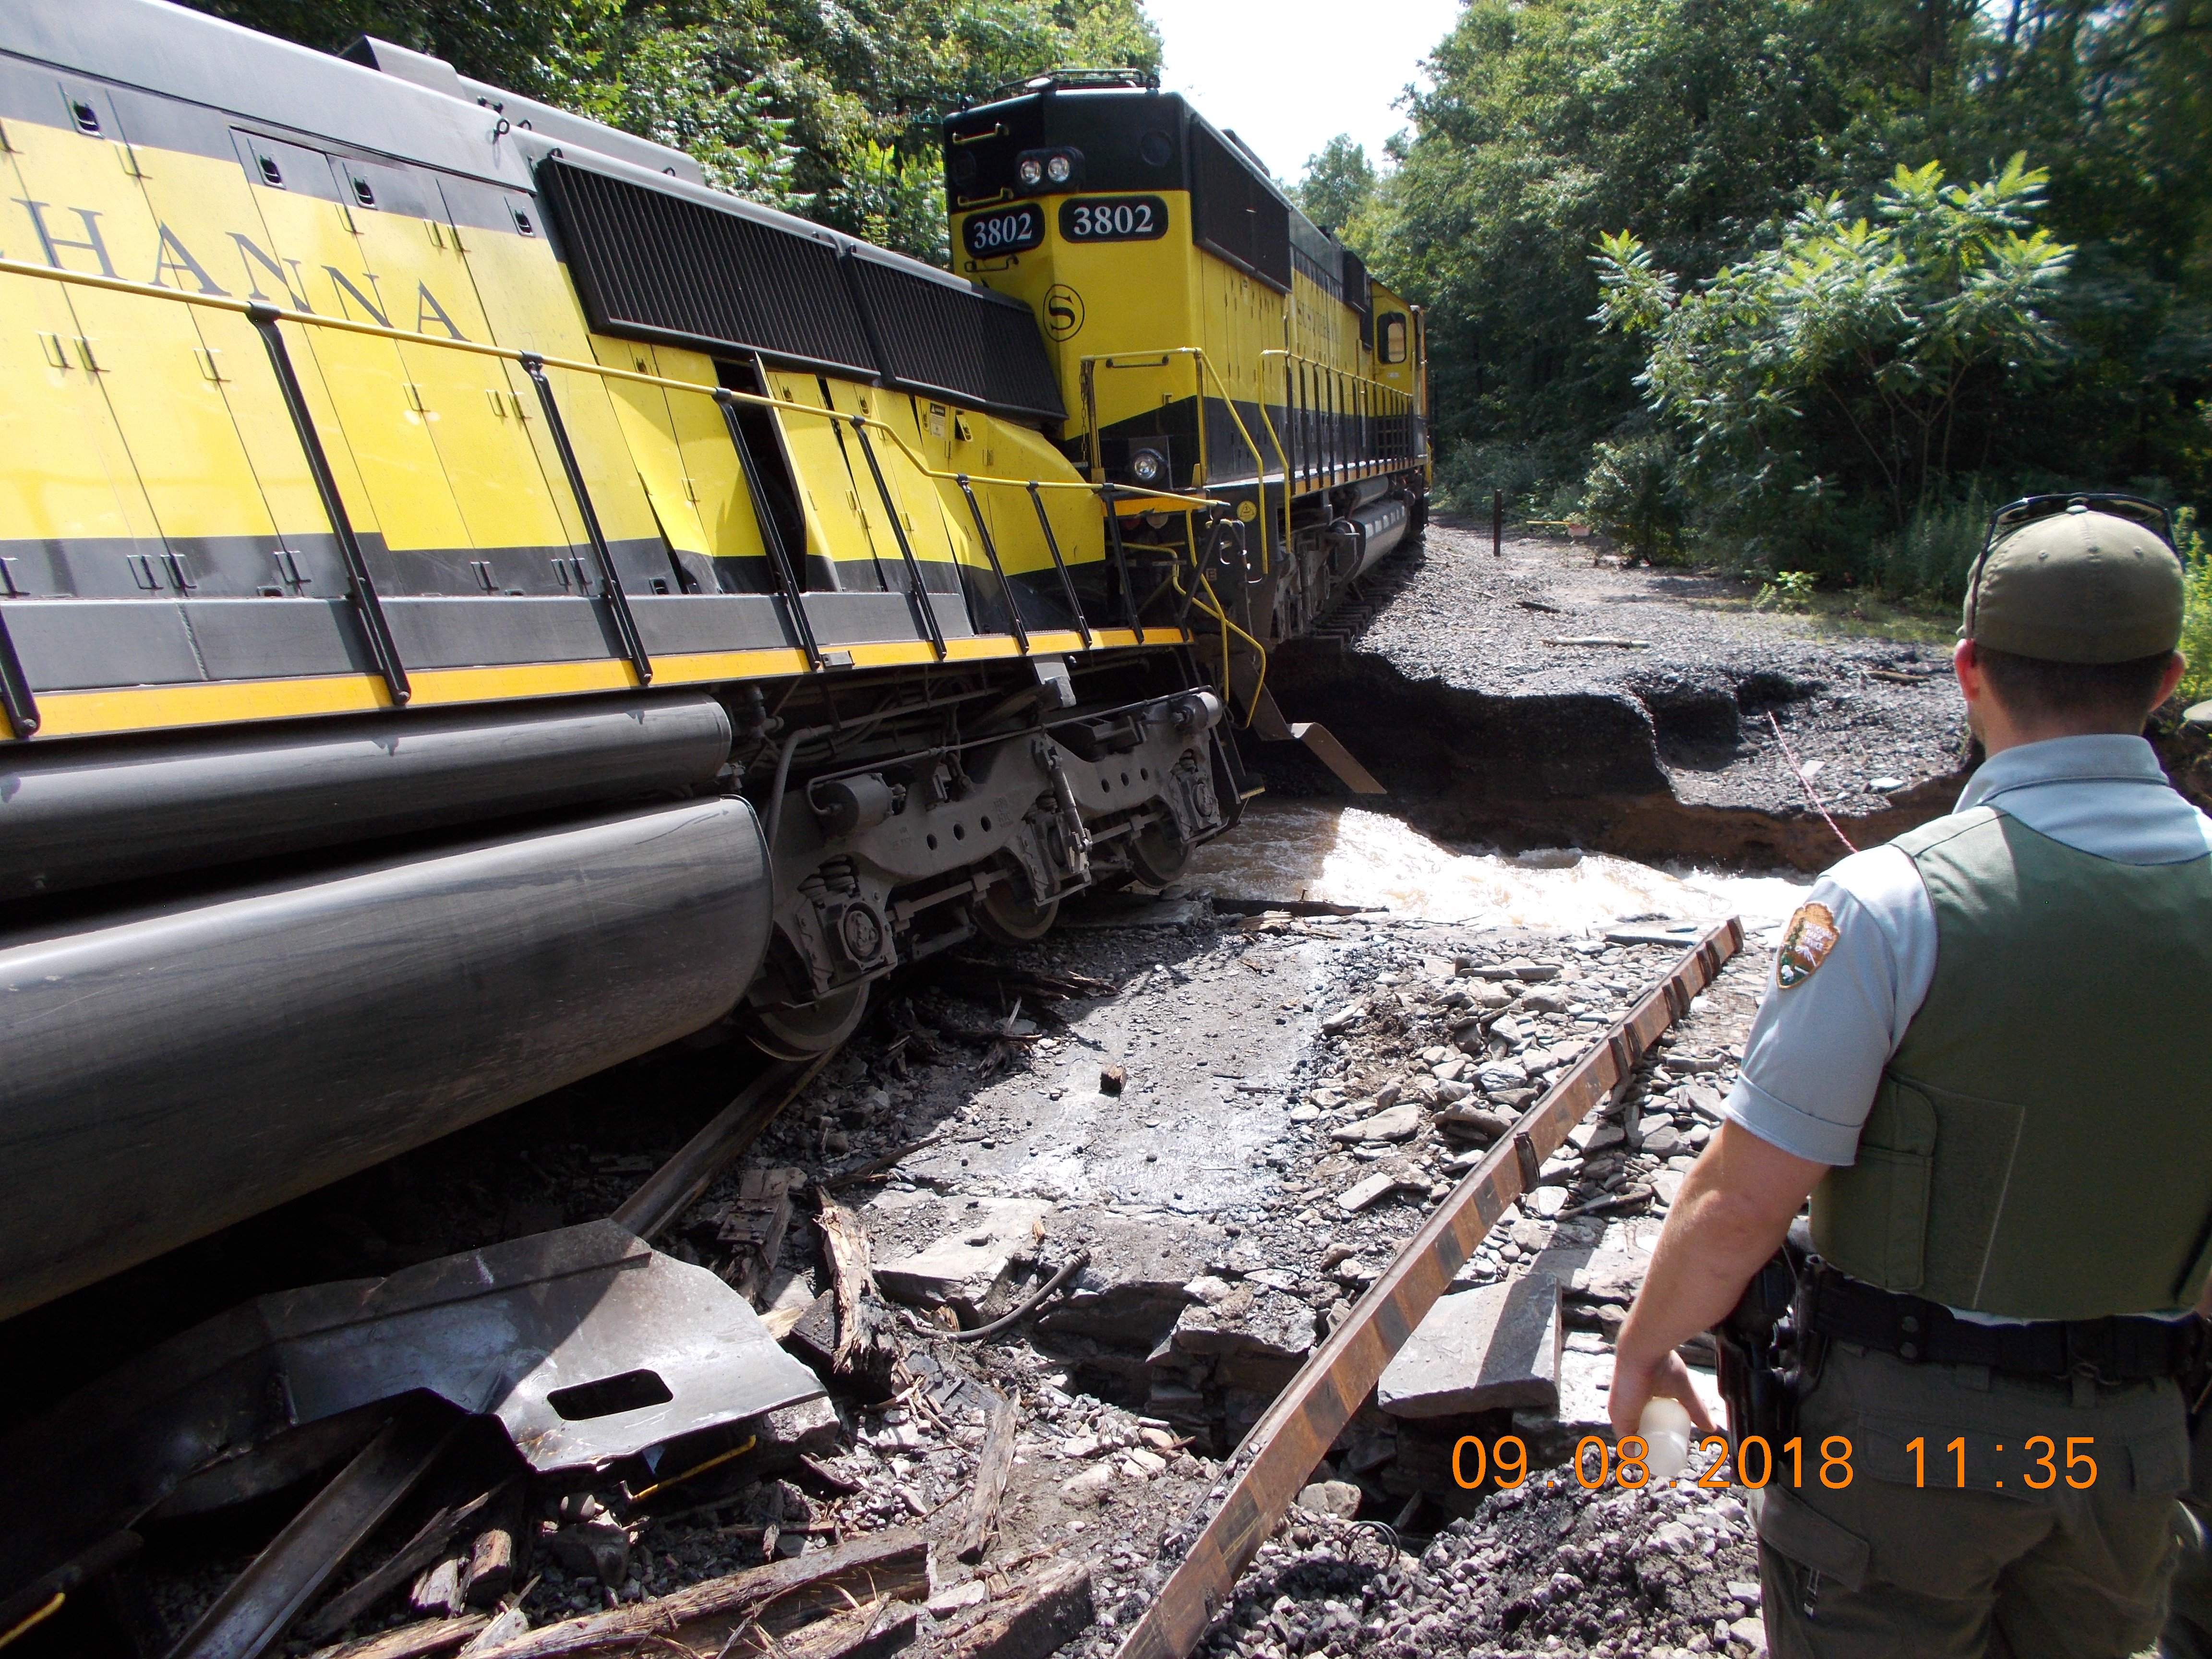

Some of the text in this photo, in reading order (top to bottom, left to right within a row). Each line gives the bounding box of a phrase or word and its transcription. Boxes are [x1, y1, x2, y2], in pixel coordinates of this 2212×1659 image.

[974, 213, 1033, 249] 3802
[1073, 204, 1154, 235] 3802
[0, 197, 473, 343] HANNA
[1048, 295, 1075, 331] S
